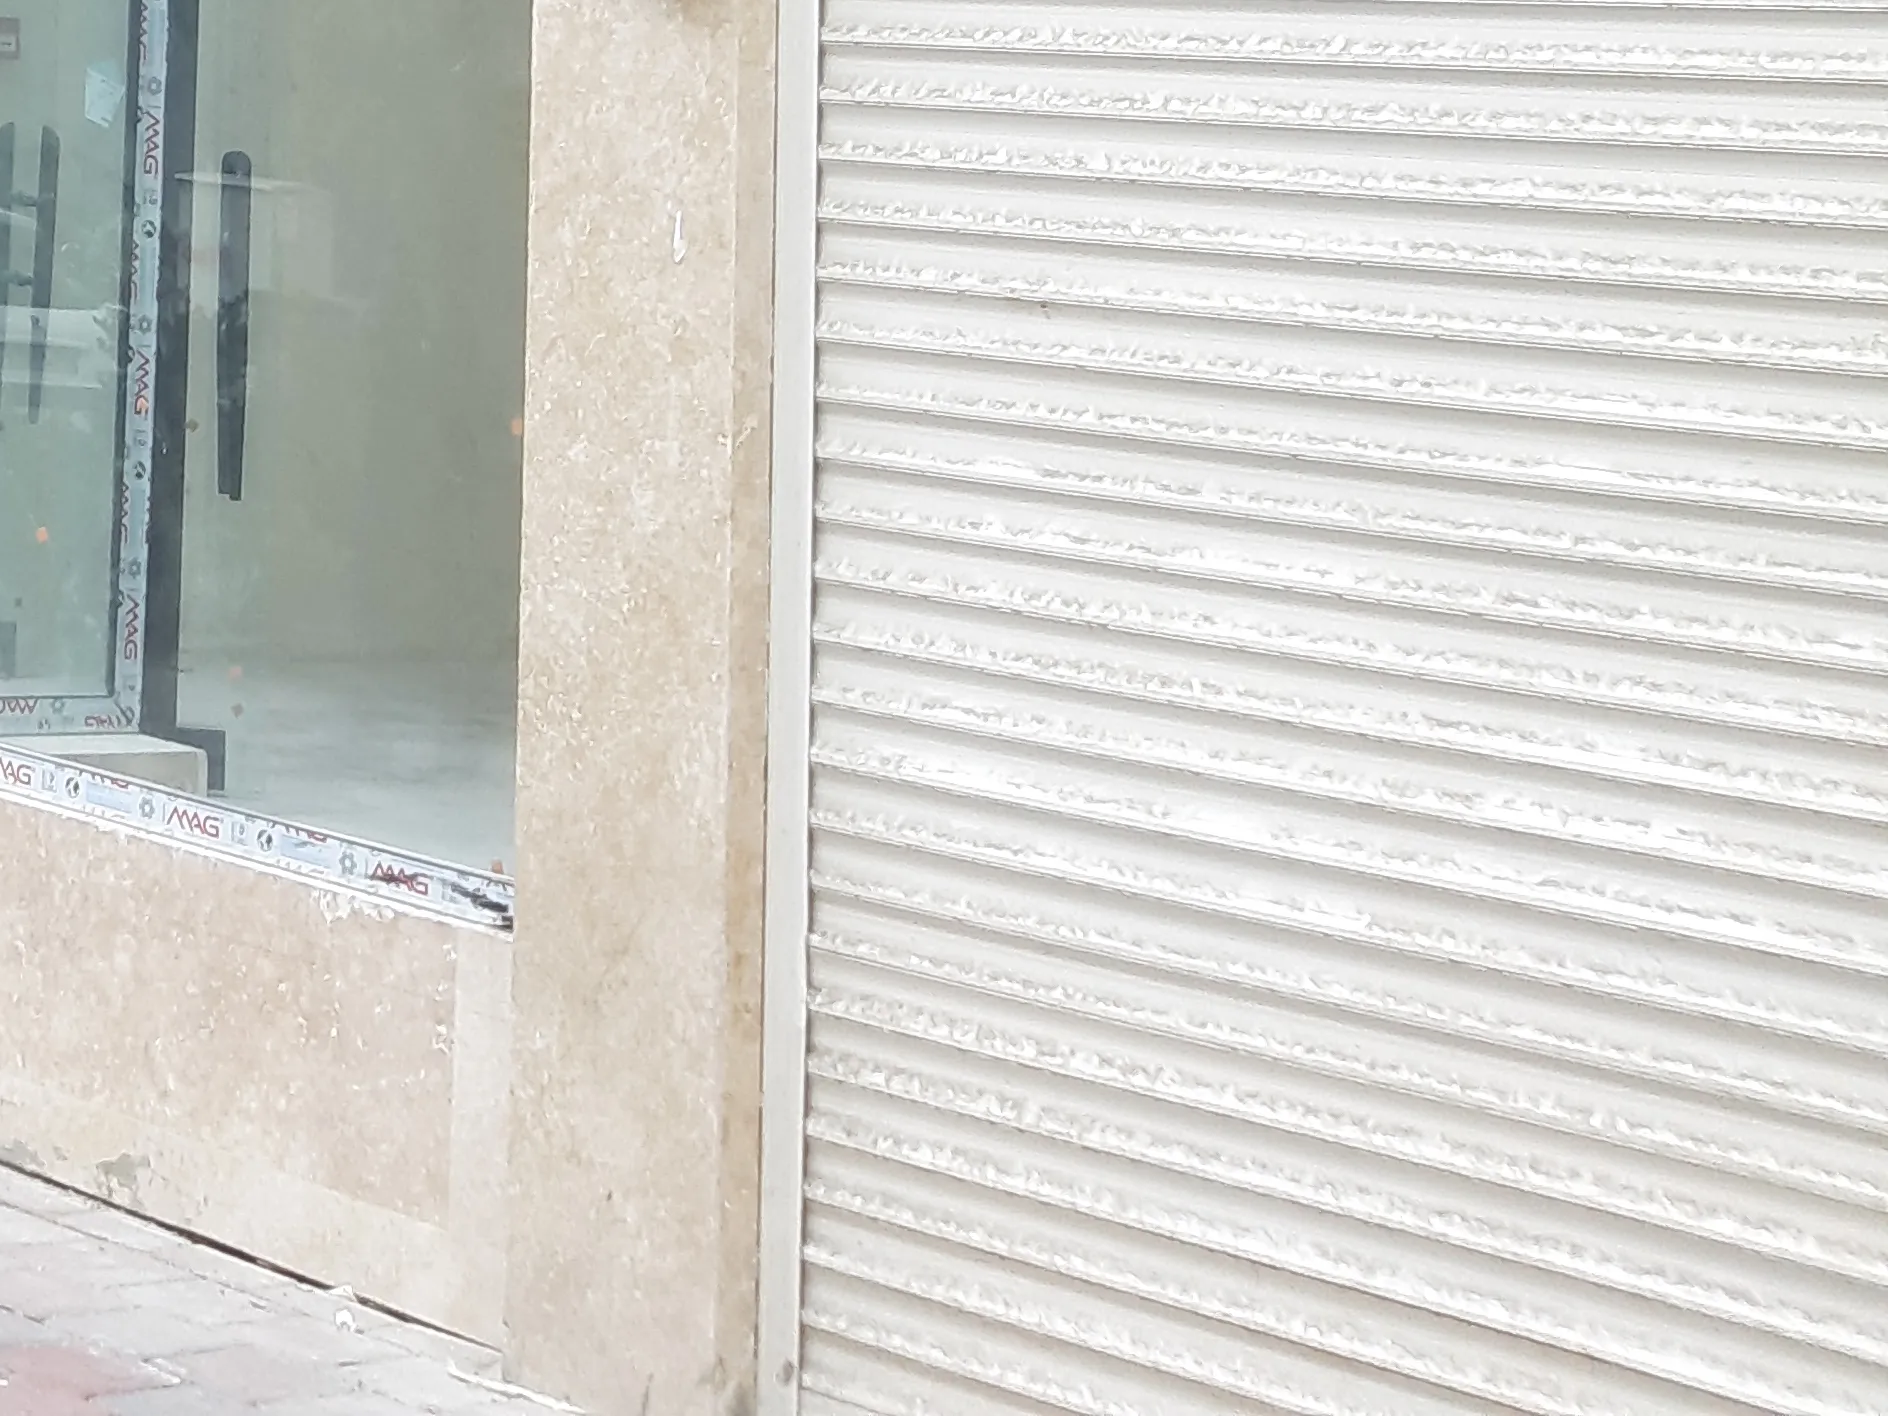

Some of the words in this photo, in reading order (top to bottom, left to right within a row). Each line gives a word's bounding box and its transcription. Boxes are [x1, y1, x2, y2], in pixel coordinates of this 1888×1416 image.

[144, 113, 160, 176] MAG
[134, 349, 150, 417] MAG
[124, 595, 140, 661] MAG
[167, 805, 221, 839] MAG
[370, 860, 428, 896] MAG
